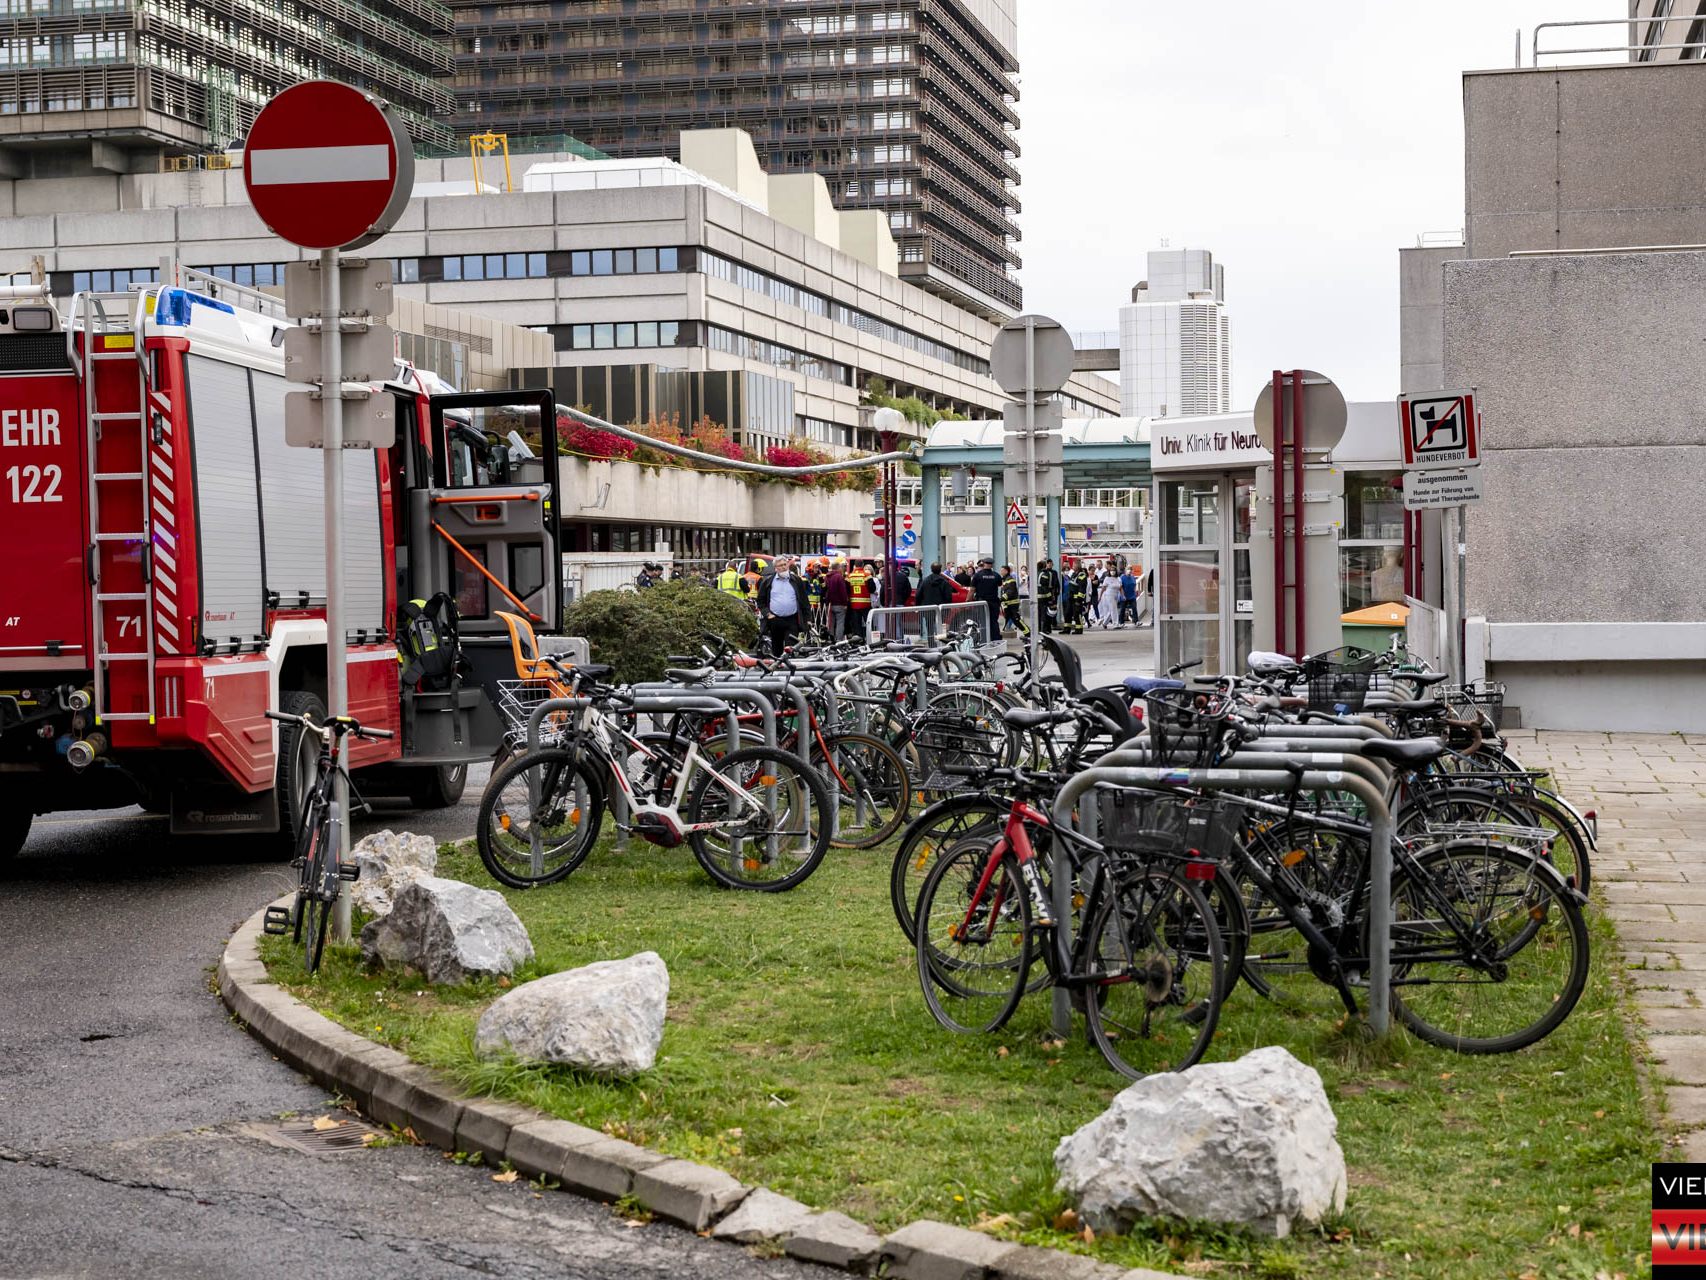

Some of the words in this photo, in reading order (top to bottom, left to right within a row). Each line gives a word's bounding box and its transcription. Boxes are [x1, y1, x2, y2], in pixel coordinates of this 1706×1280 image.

[2, 409, 61, 446] EHR
[1161, 436, 1183, 455] Univ.
[1186, 433, 1212, 453] Klinik
[1214, 432, 1228, 451] für
[1416, 452, 1465, 463] HUNDEVERBOT
[6, 464, 63, 503] 122
[1417, 474, 1468, 484] ausgenommen
[5, 617, 21, 626] AT
[116, 616, 142, 637] 71
[205, 677, 216, 699] 71
